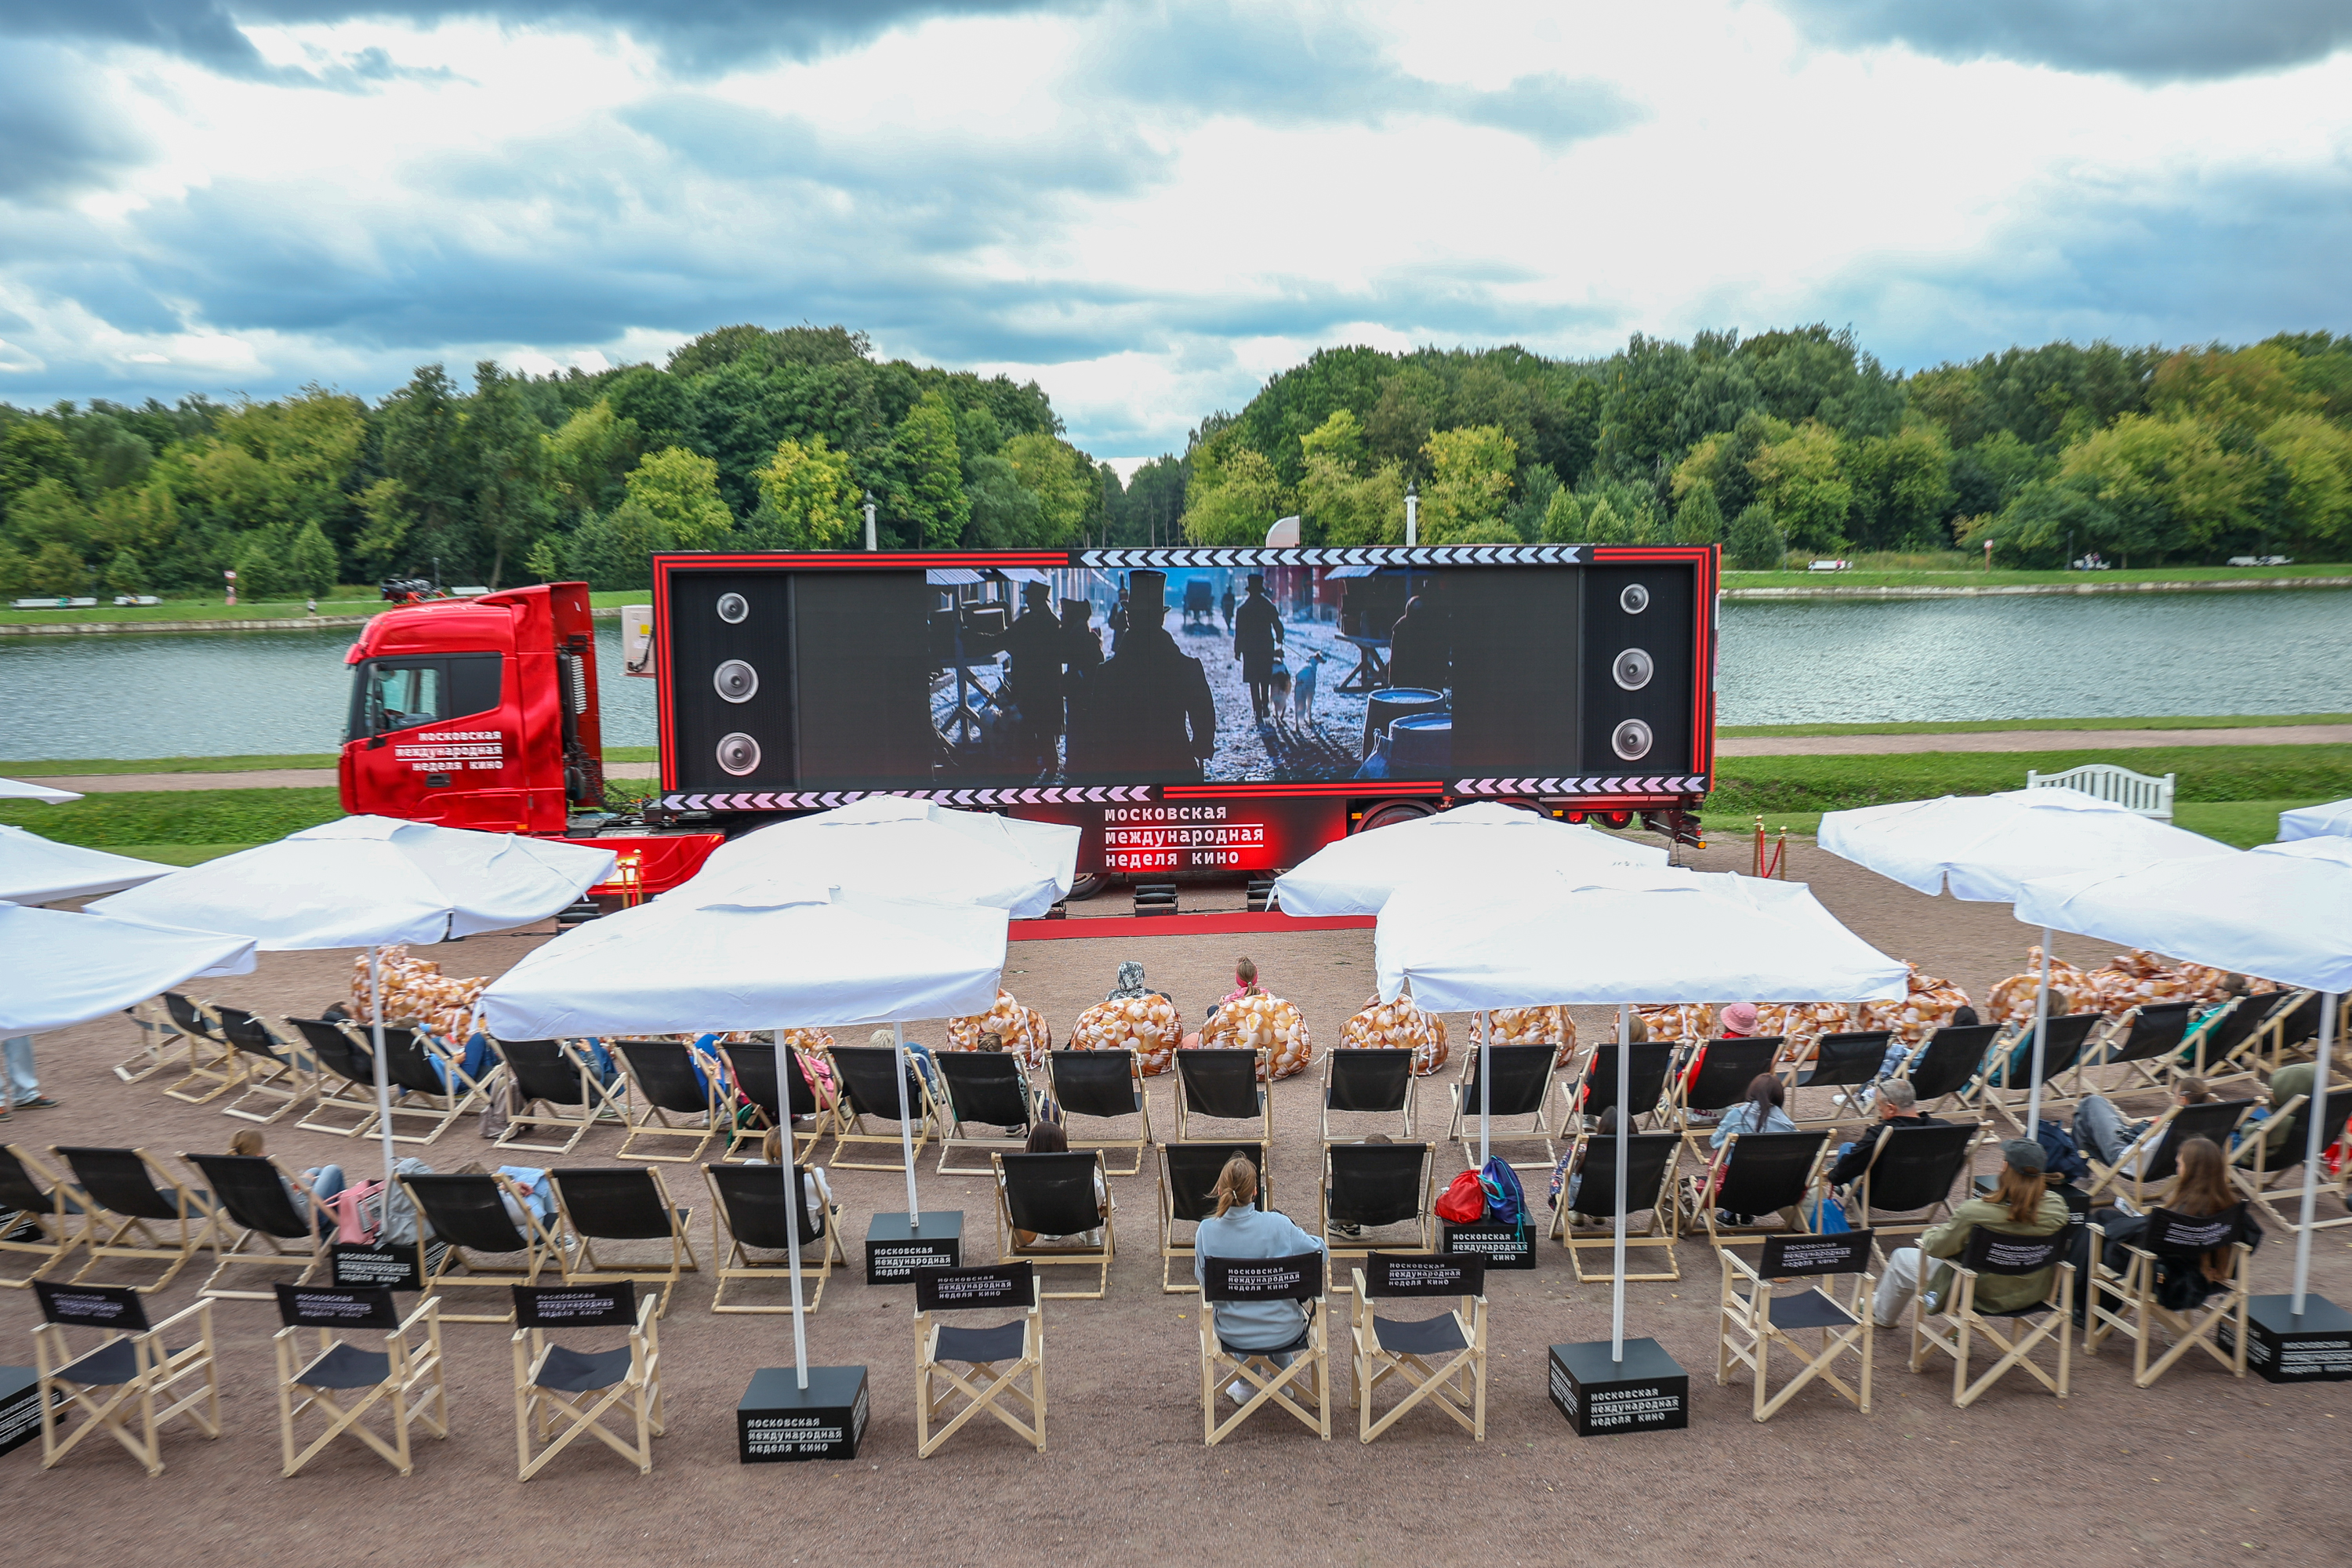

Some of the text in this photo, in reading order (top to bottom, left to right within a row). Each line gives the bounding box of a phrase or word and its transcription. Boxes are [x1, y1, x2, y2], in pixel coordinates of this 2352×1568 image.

[418, 731, 502, 741] московская
[412, 760, 503, 772] неделя кино
[1105, 806, 1226, 822] московская
[1105, 828, 1264, 848] международная
[1106, 851, 1239, 869] неделя кино
[874, 1247, 933, 1255] московская
[875, 1257, 950, 1267] международная
[875, 1269, 910, 1277] неделя
[1229, 1273, 1300, 1284] международная
[1389, 1270, 1461, 1279] международная
[938, 1281, 1011, 1291] международная
[1591, 1388, 1659, 1402] московская
[1591, 1399, 1679, 1414] международная
[747, 1417, 820, 1428] московская
[1591, 1413, 1665, 1427] неделя кино
[748, 1430, 842, 1443] международная
[749, 1443, 828, 1454] неделя кино
